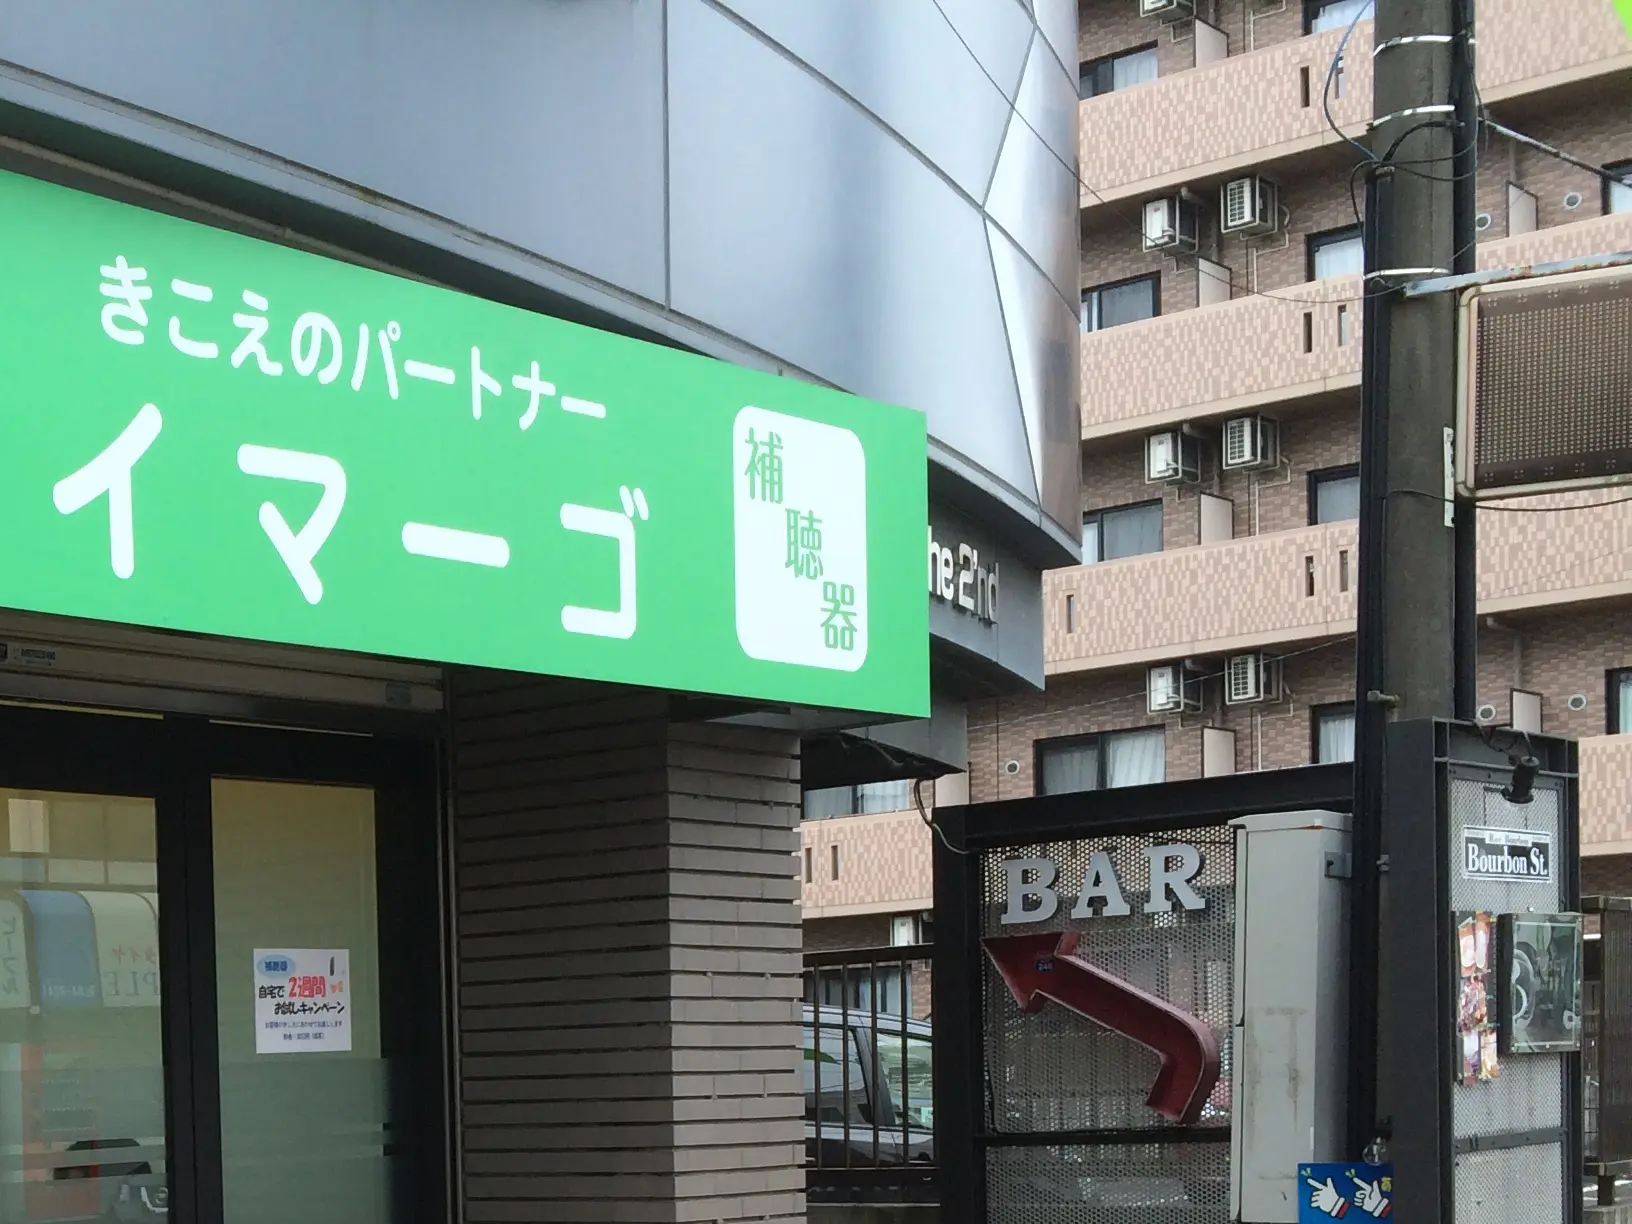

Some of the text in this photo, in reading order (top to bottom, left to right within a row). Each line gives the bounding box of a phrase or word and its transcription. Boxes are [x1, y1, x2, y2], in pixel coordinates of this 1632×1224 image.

[98, 254, 607, 431] きこえのパートナー
[52, 402, 649, 640] イマーゴ
[744, 426, 859, 652] 補聴器
[1001, 843, 1206, 925] BAR
[1468, 844, 1548, 876] Bourbon St.
